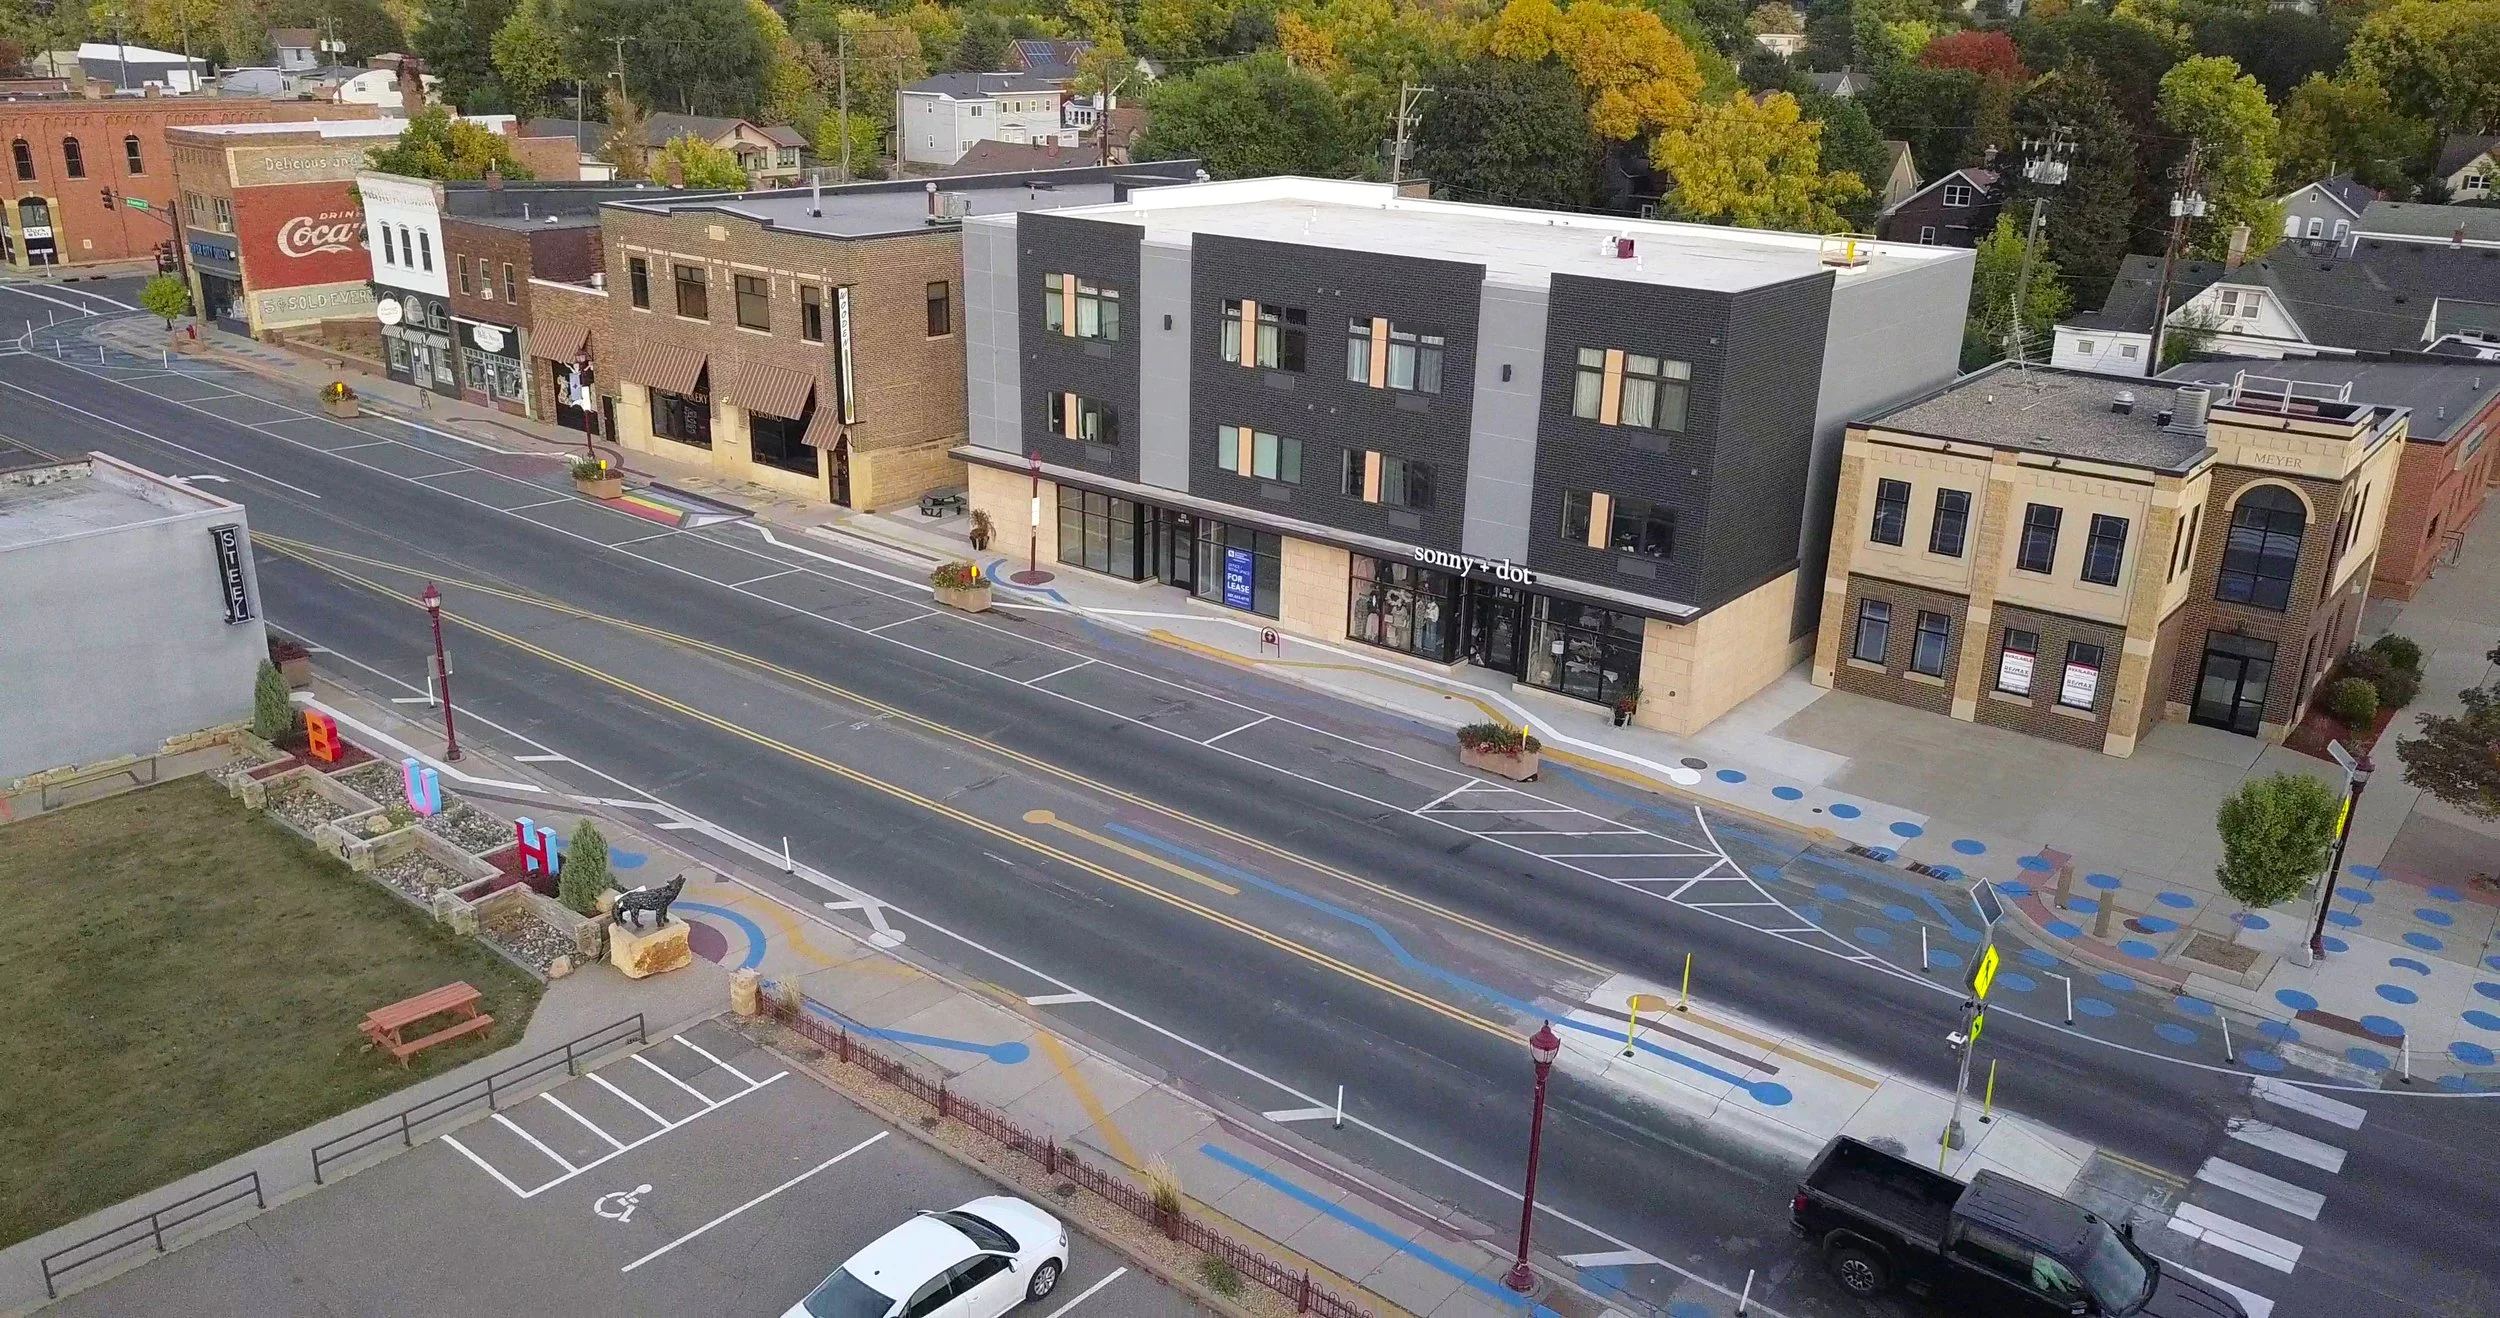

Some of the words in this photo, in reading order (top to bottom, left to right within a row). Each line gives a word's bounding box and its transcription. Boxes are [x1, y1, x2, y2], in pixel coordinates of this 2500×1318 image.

[264, 157, 326, 171] Delicious
[333, 153, 358, 168] and
[287, 295, 327, 310] SOLD
[839, 291, 849, 348] WOODEN
[2255, 453, 2302, 468] MEYER
[1414, 547, 1474, 577] sonny
[1480, 562, 1489, 573] +
[1496, 559, 1532, 585] dot
[223, 532, 246, 618] STEEL
[1227, 573, 1242, 583] FOR
[1227, 581, 1250, 594] LEASE
[2005, 653, 2033, 663] AVAILABLE
[2004, 665, 2029, 674] RE/MAX
[2068, 667, 2096, 677] AVAILABLE
[2067, 679, 2093, 689] RE/MAX
